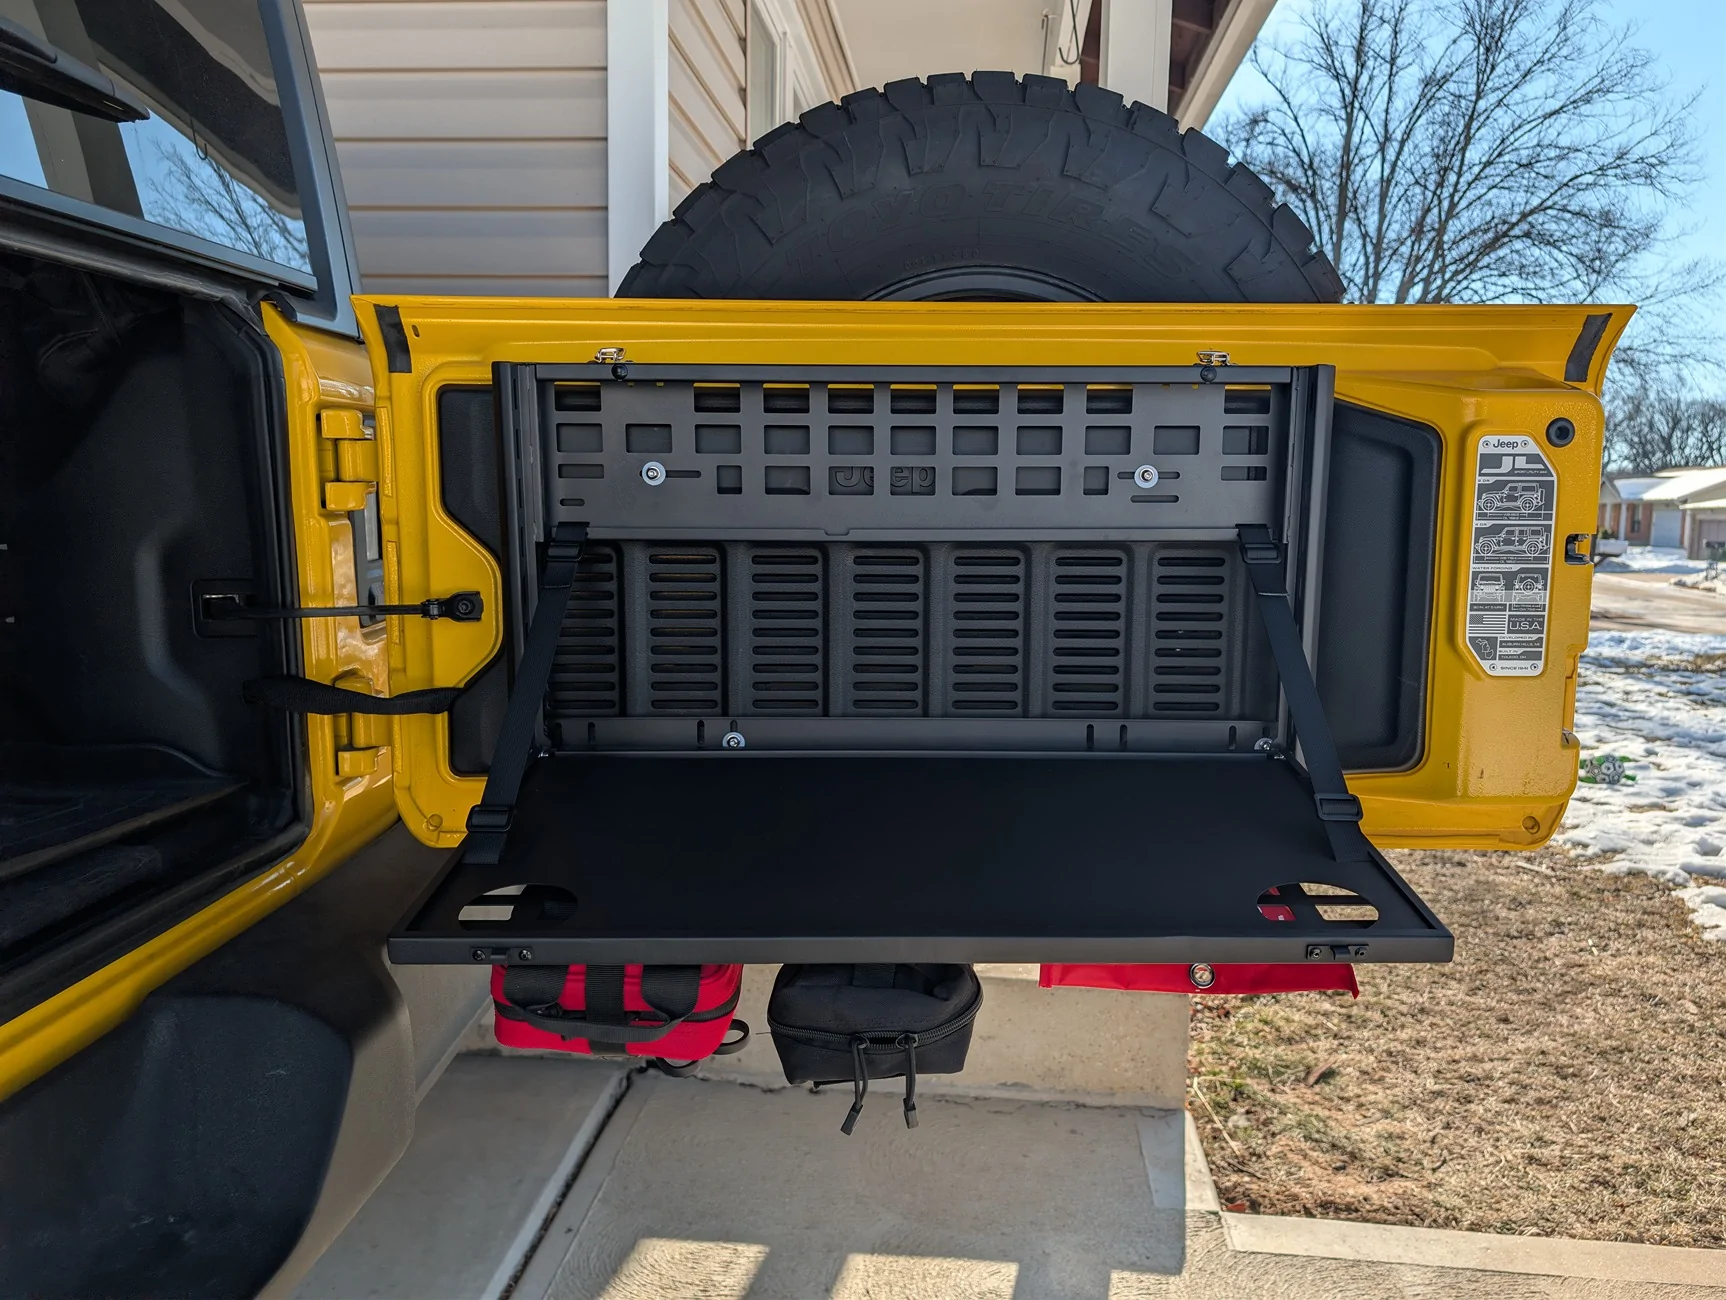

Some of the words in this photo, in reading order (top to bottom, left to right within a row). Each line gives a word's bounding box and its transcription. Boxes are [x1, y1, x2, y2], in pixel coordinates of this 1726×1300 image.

[1493, 439, 1519, 450] Jeep
[1480, 456, 1545, 474] JL
[1509, 622, 1543, 630] U.S.A.
